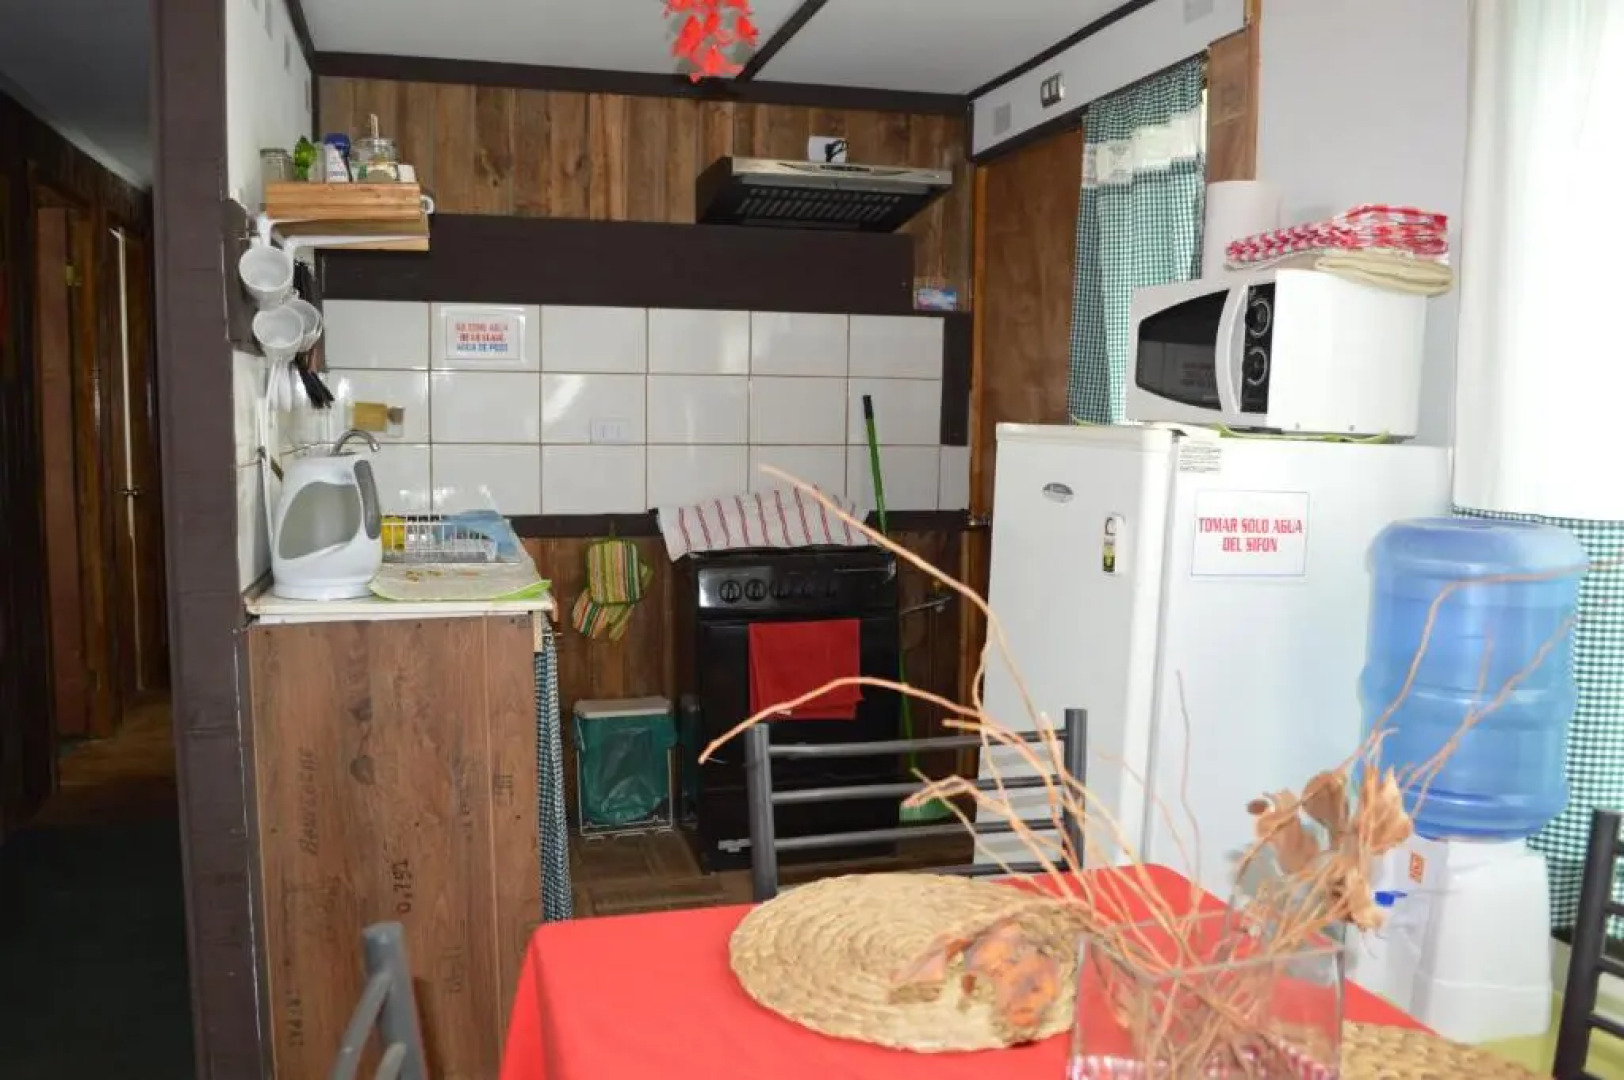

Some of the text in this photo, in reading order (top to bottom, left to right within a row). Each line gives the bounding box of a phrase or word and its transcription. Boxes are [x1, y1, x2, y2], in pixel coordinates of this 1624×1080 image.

[1198, 517, 1303, 534] TOMAR SOLO AGUA
[1222, 537, 1278, 553] DEL SIFON
